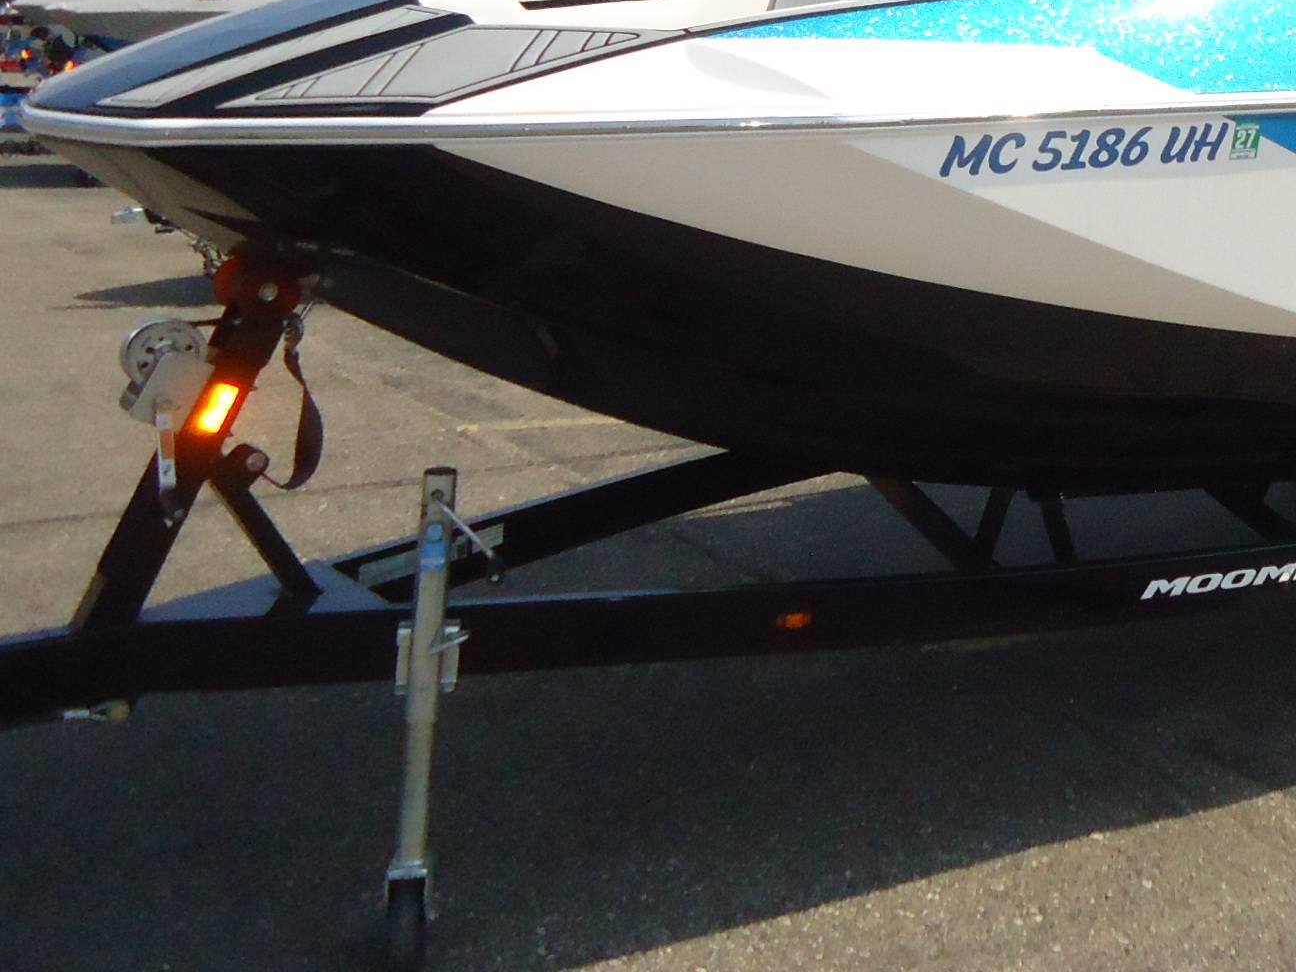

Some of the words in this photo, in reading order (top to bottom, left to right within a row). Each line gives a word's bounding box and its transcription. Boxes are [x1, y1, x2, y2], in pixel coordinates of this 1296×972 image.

[939, 134, 1026, 178] MC
[1031, 126, 1153, 172] 5186
[1160, 122, 1230, 165] UH
[1235, 129, 1257, 149] 27
